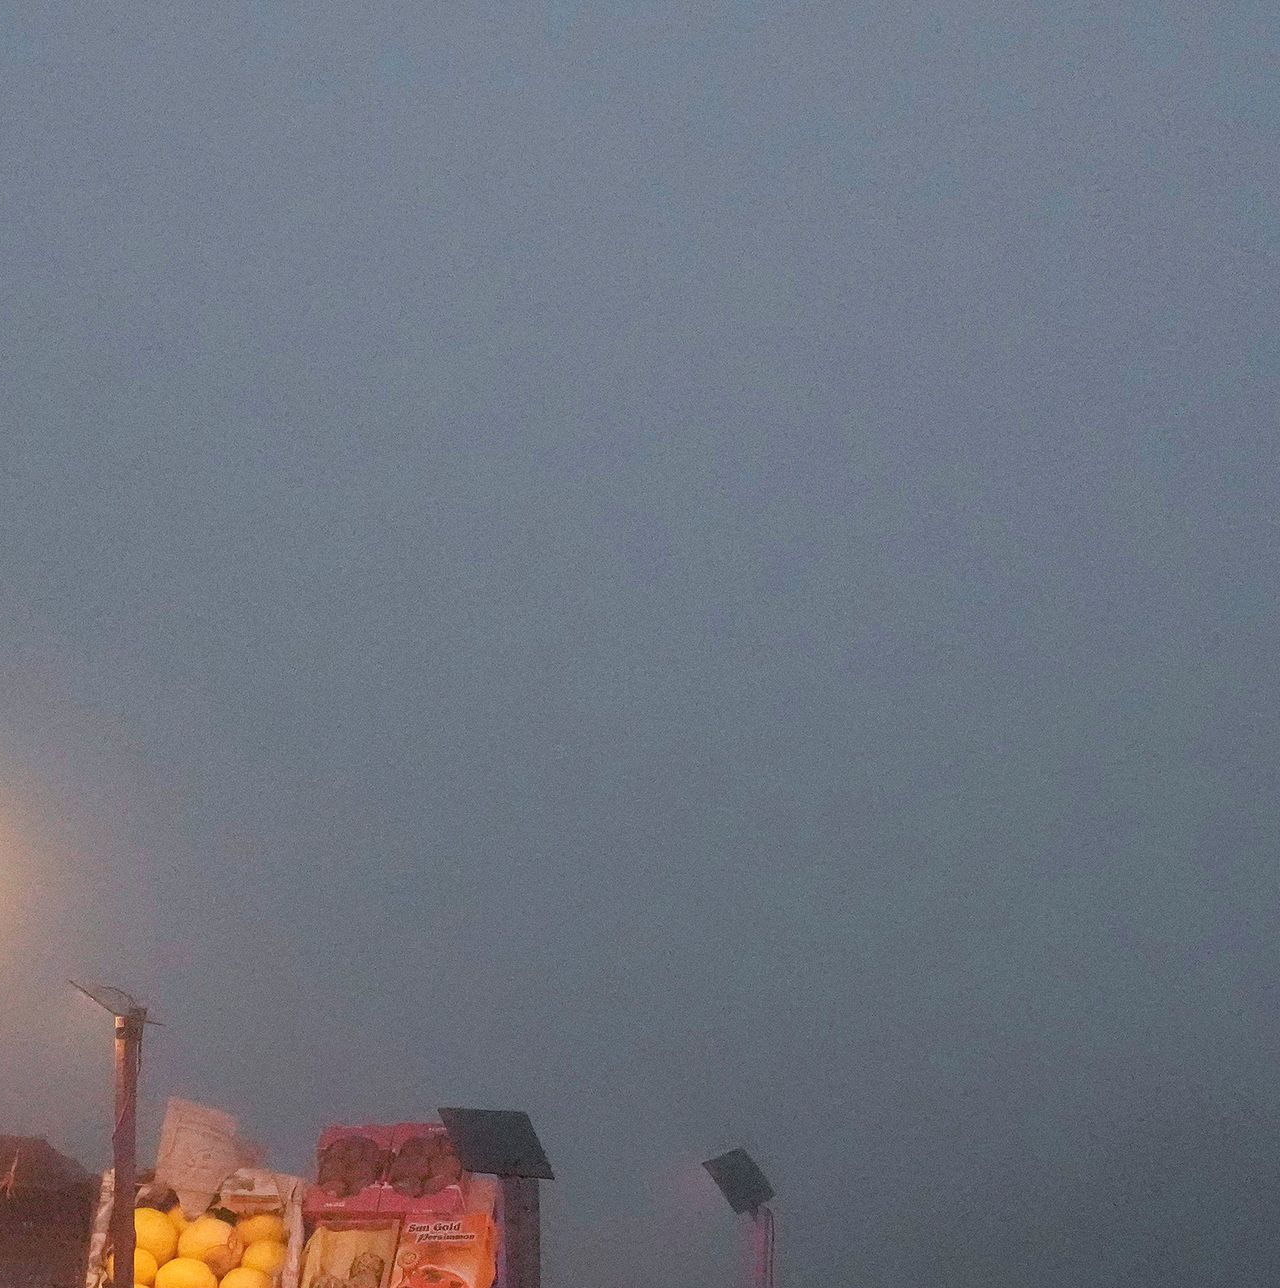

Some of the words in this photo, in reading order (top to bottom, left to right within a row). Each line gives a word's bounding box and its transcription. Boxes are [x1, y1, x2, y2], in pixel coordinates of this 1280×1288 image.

[408, 1224, 430, 1232] Sun
[433, 1221, 462, 1232] Gold
[417, 1233, 475, 1243] Persimmon
